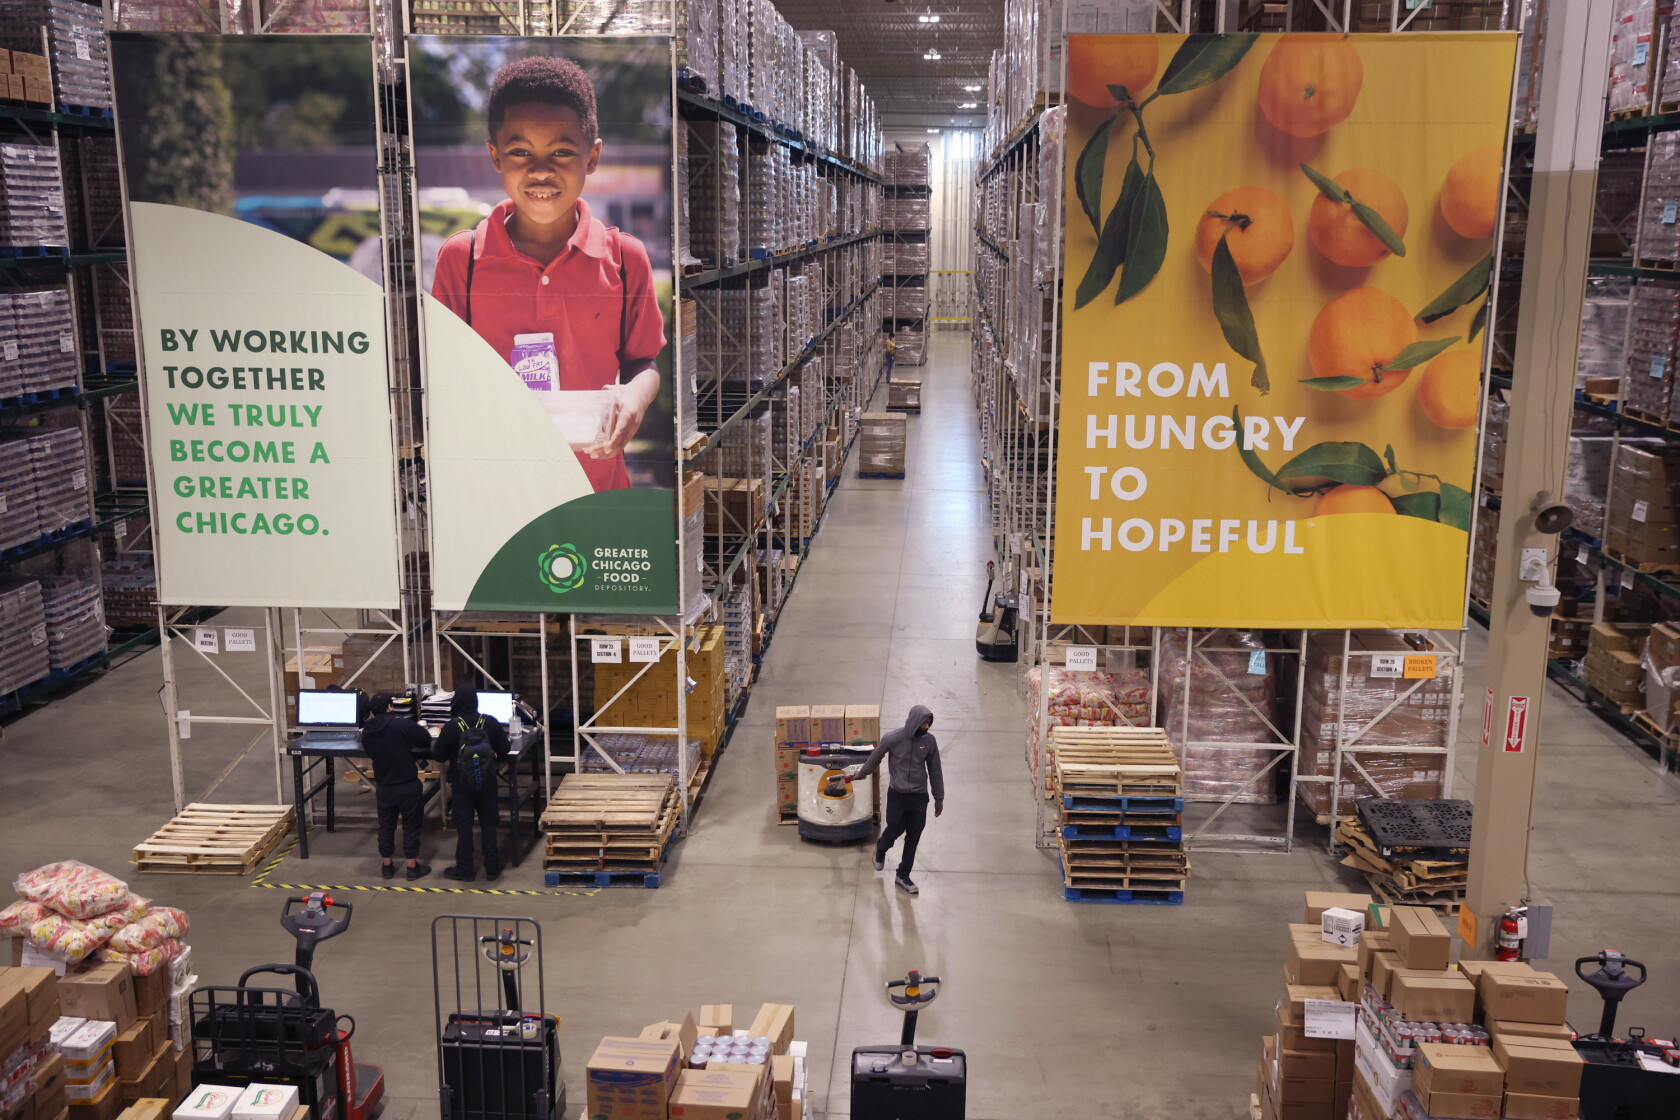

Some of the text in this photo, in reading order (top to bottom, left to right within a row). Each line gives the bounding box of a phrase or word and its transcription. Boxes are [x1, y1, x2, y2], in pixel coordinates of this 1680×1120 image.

[160, 329, 370, 354] BY WORKING
[162, 366, 326, 391] TOGETHER
[1087, 361, 1230, 398] FROM
[166, 403, 323, 427] WE TRULY
[1086, 414, 1306, 451] HUNGRY
[169, 439, 331, 464] BECOME A
[173, 475, 310, 500] GREATER
[1084, 466, 1148, 501] TO
[175, 511, 330, 536] CHICAGO.
[1081, 517, 1305, 554] HOPEFUL
[594, 547, 649, 558] GREATER
[592, 560, 651, 571] CHICAGO
[603, 572, 640, 583] FOOD
